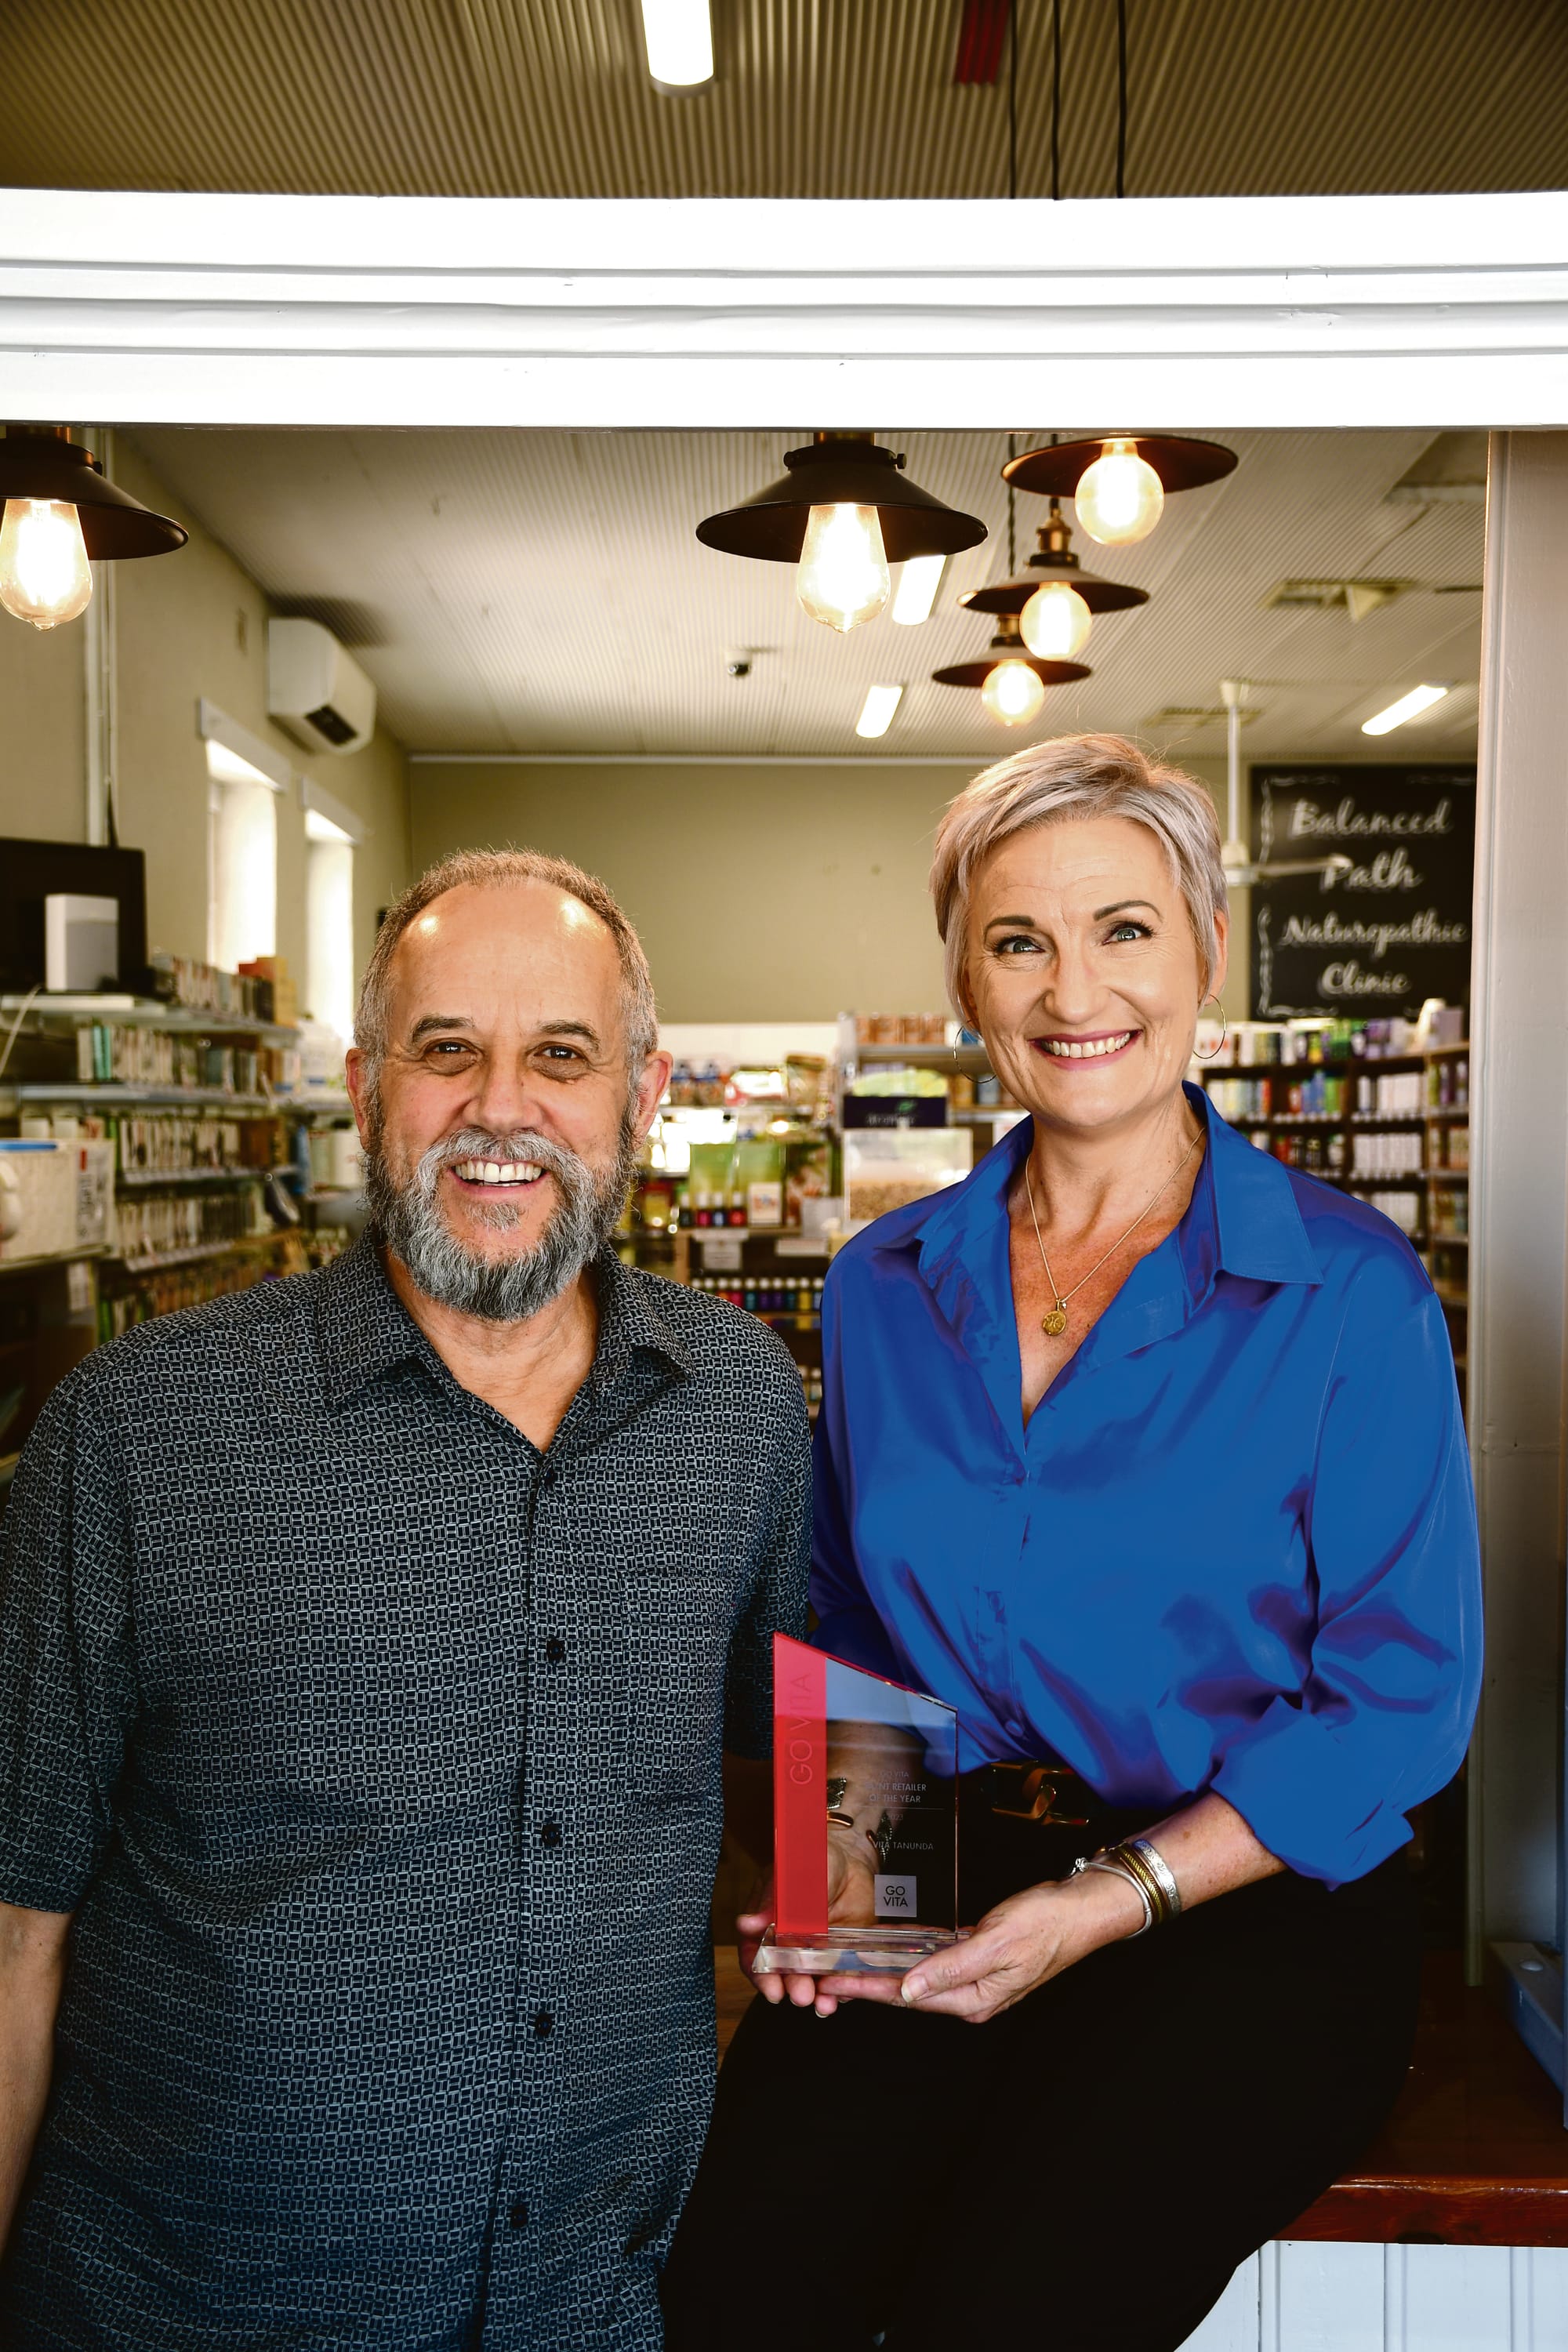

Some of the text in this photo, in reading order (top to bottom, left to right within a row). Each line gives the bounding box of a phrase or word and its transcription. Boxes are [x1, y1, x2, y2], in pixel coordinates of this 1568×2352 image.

[1290, 797, 1451, 839] Balanced
[1320, 848, 1423, 894] Path
[1275, 908, 1468, 961] Naturopathic
[1318, 960, 1411, 999] Clinic
[789, 1739, 813, 1785] GO
[869, 1793, 921, 1803] OF THE YEAR
[892, 1783, 927, 1791] RETAILER
[893, 1842, 934, 1851] TANUNDA
[883, 1896, 909, 1907] VITA
[885, 1886, 906, 1896] GO
